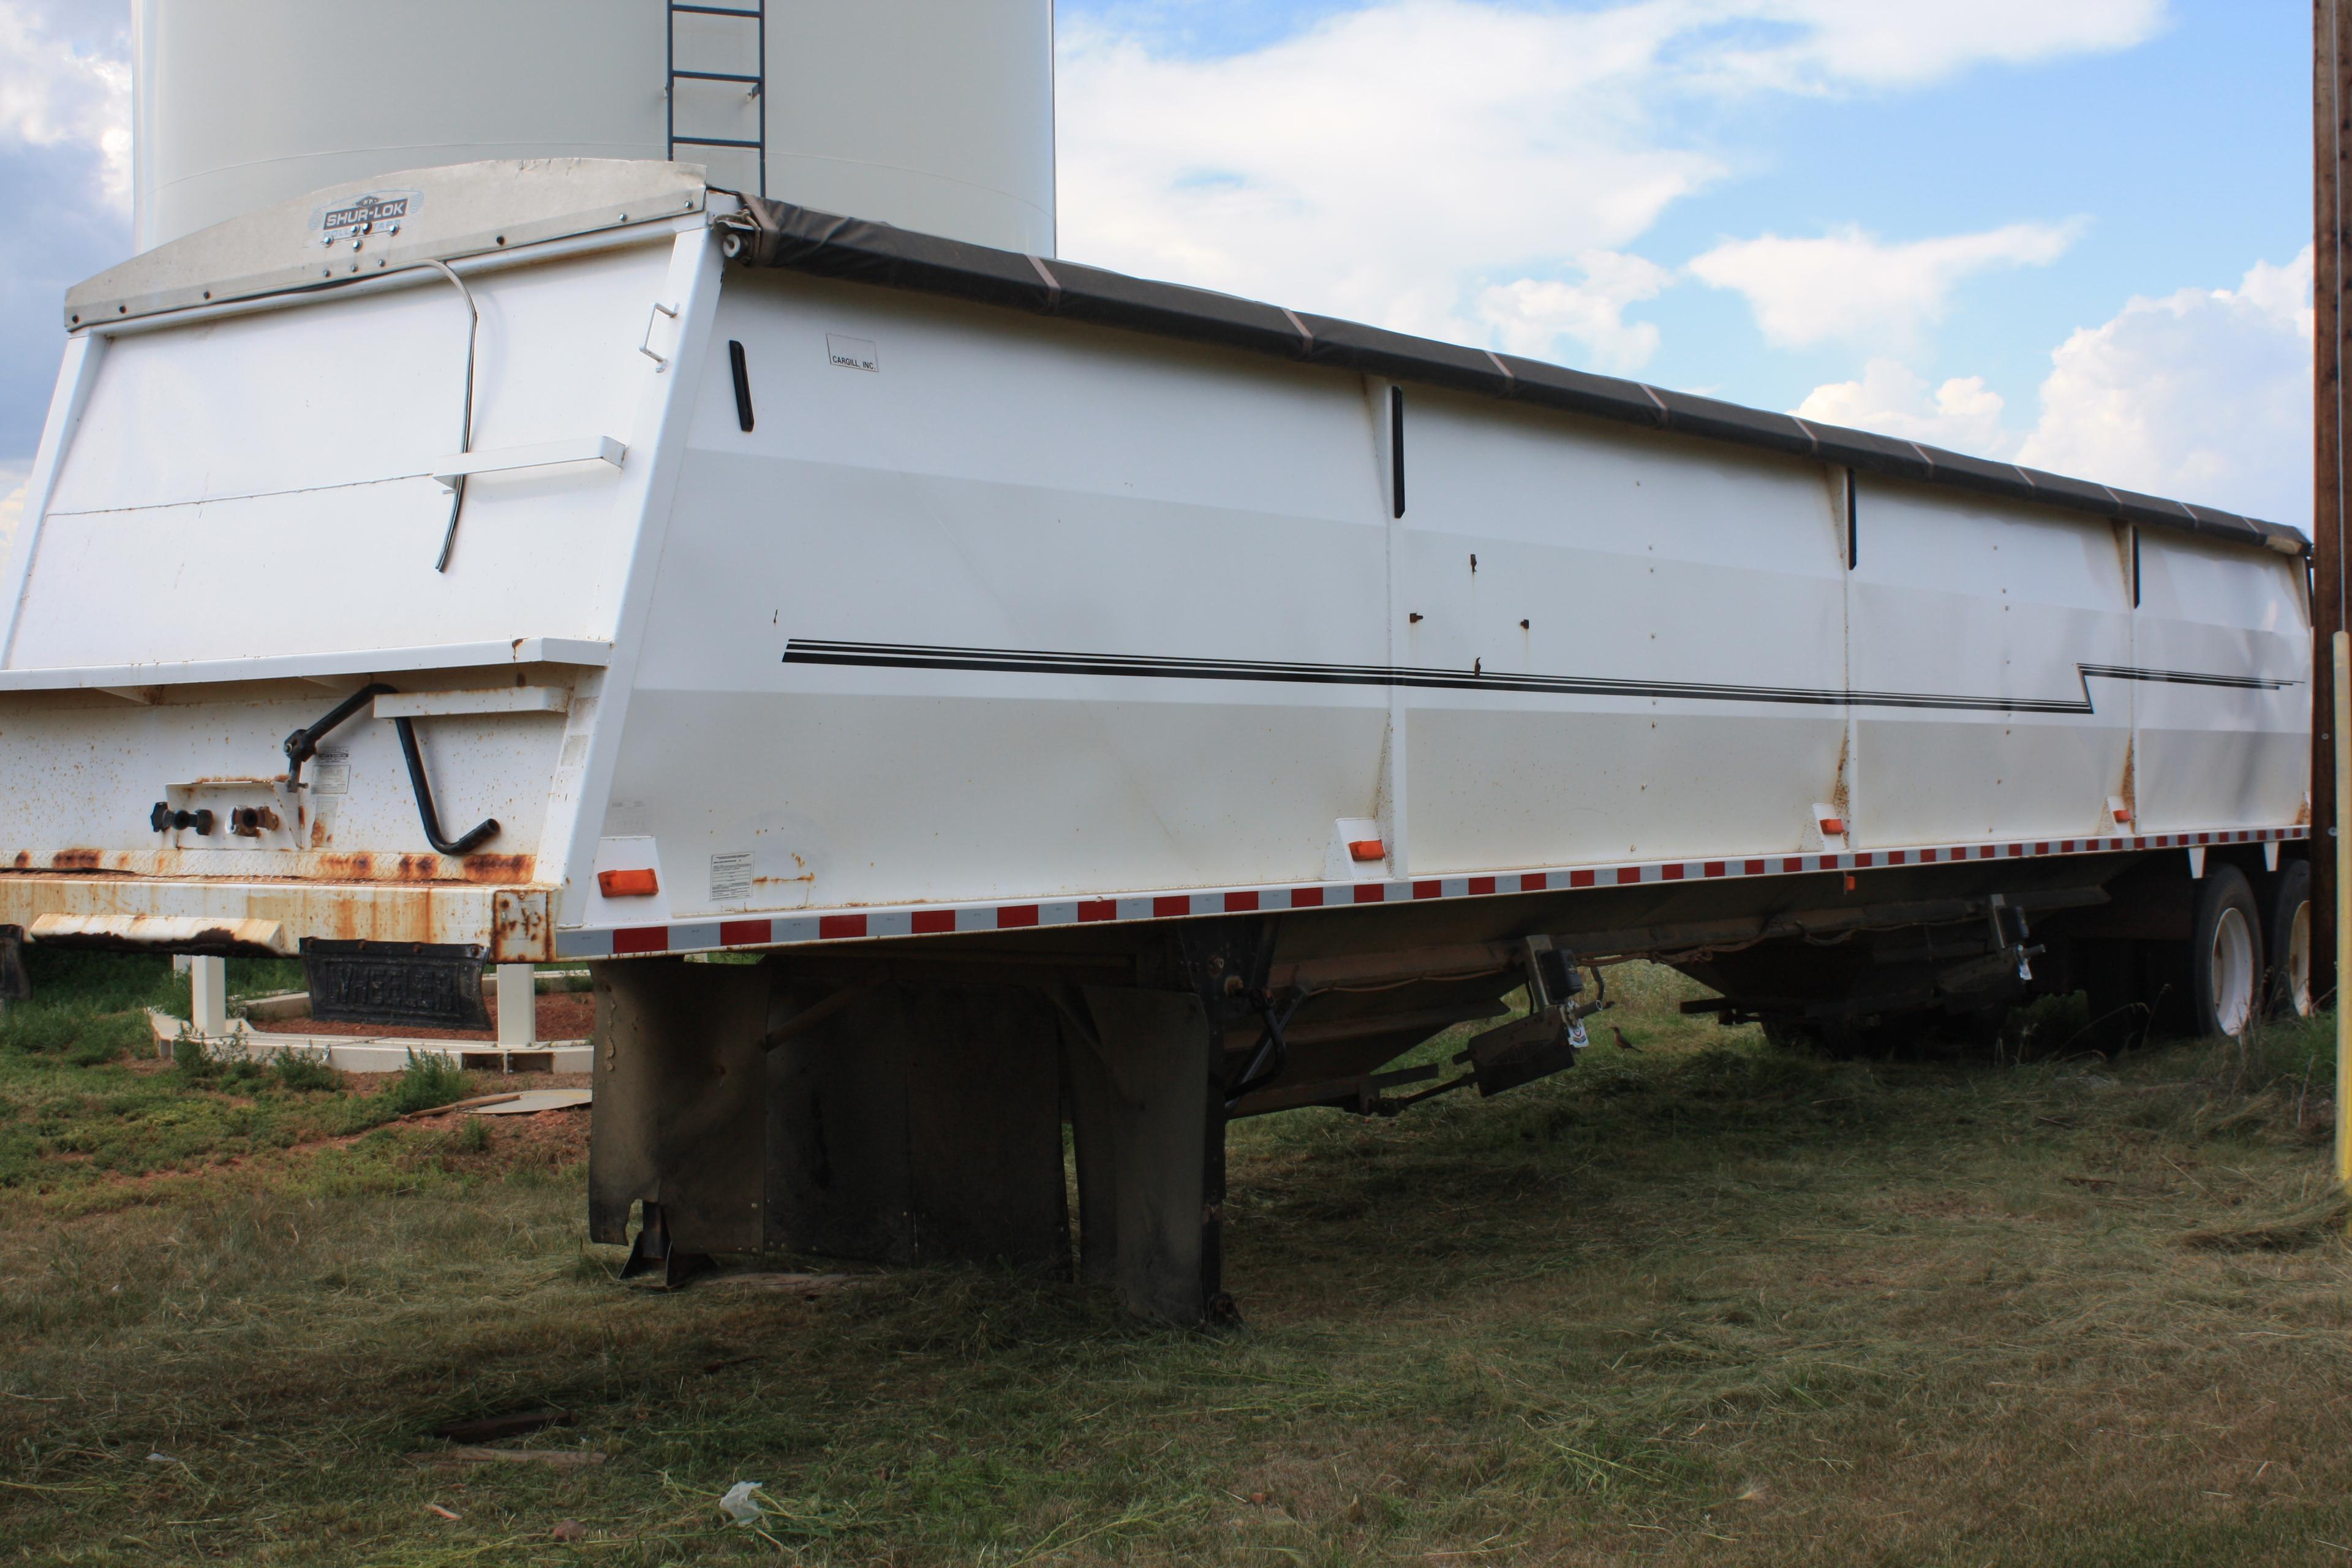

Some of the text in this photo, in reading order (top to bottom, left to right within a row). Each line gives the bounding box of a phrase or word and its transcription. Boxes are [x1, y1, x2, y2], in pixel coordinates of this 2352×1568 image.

[326, 202, 405, 227] SHUR-LOK
[832, 356, 876, 369] CARGILL, INC.
[328, 964, 453, 1009] WHEELER
